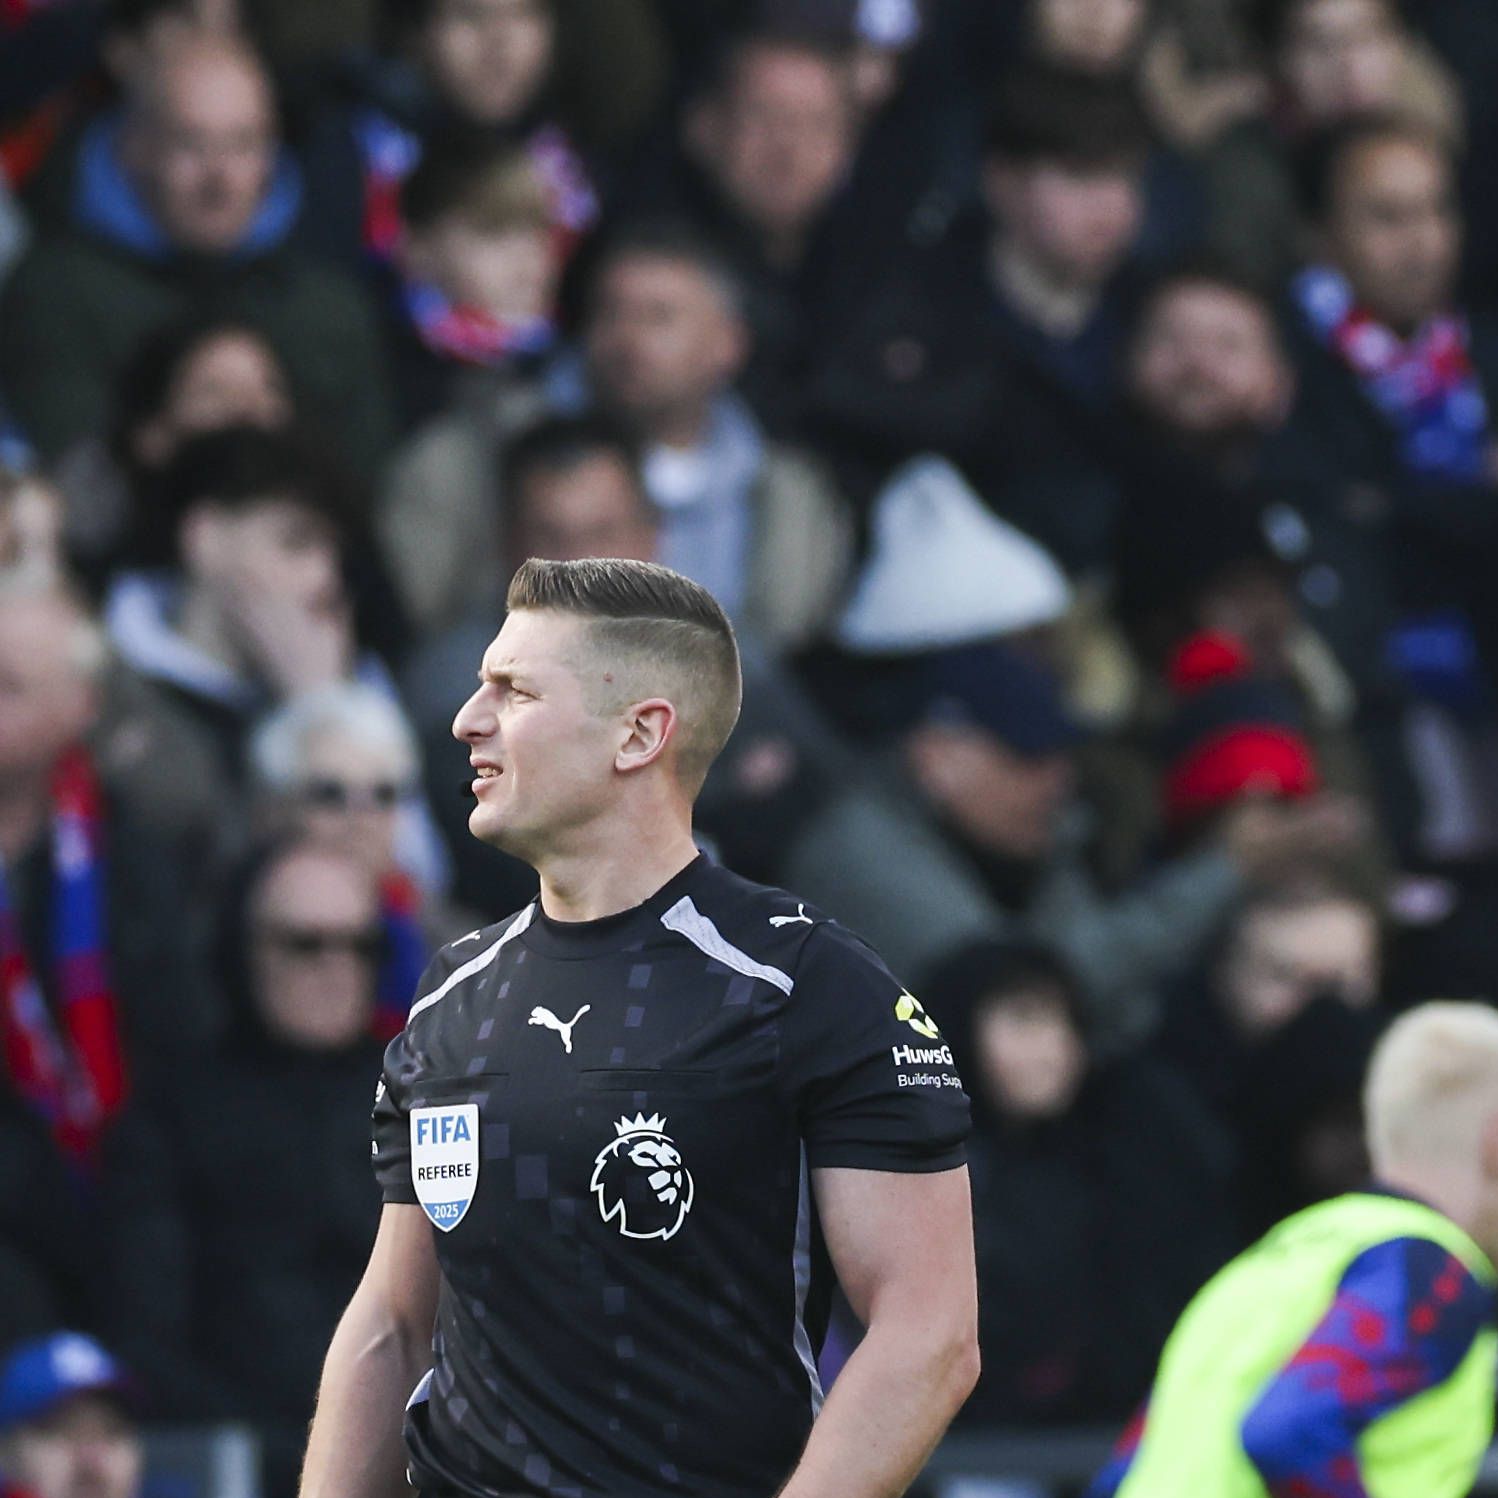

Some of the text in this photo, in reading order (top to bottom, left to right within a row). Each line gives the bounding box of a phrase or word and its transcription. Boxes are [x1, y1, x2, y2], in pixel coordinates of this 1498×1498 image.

[897, 1073, 941, 1088] Building
[417, 1114, 471, 1146] FIFA
[418, 1163, 472, 1181] REFEREE
[434, 1204, 460, 1218] 2025
